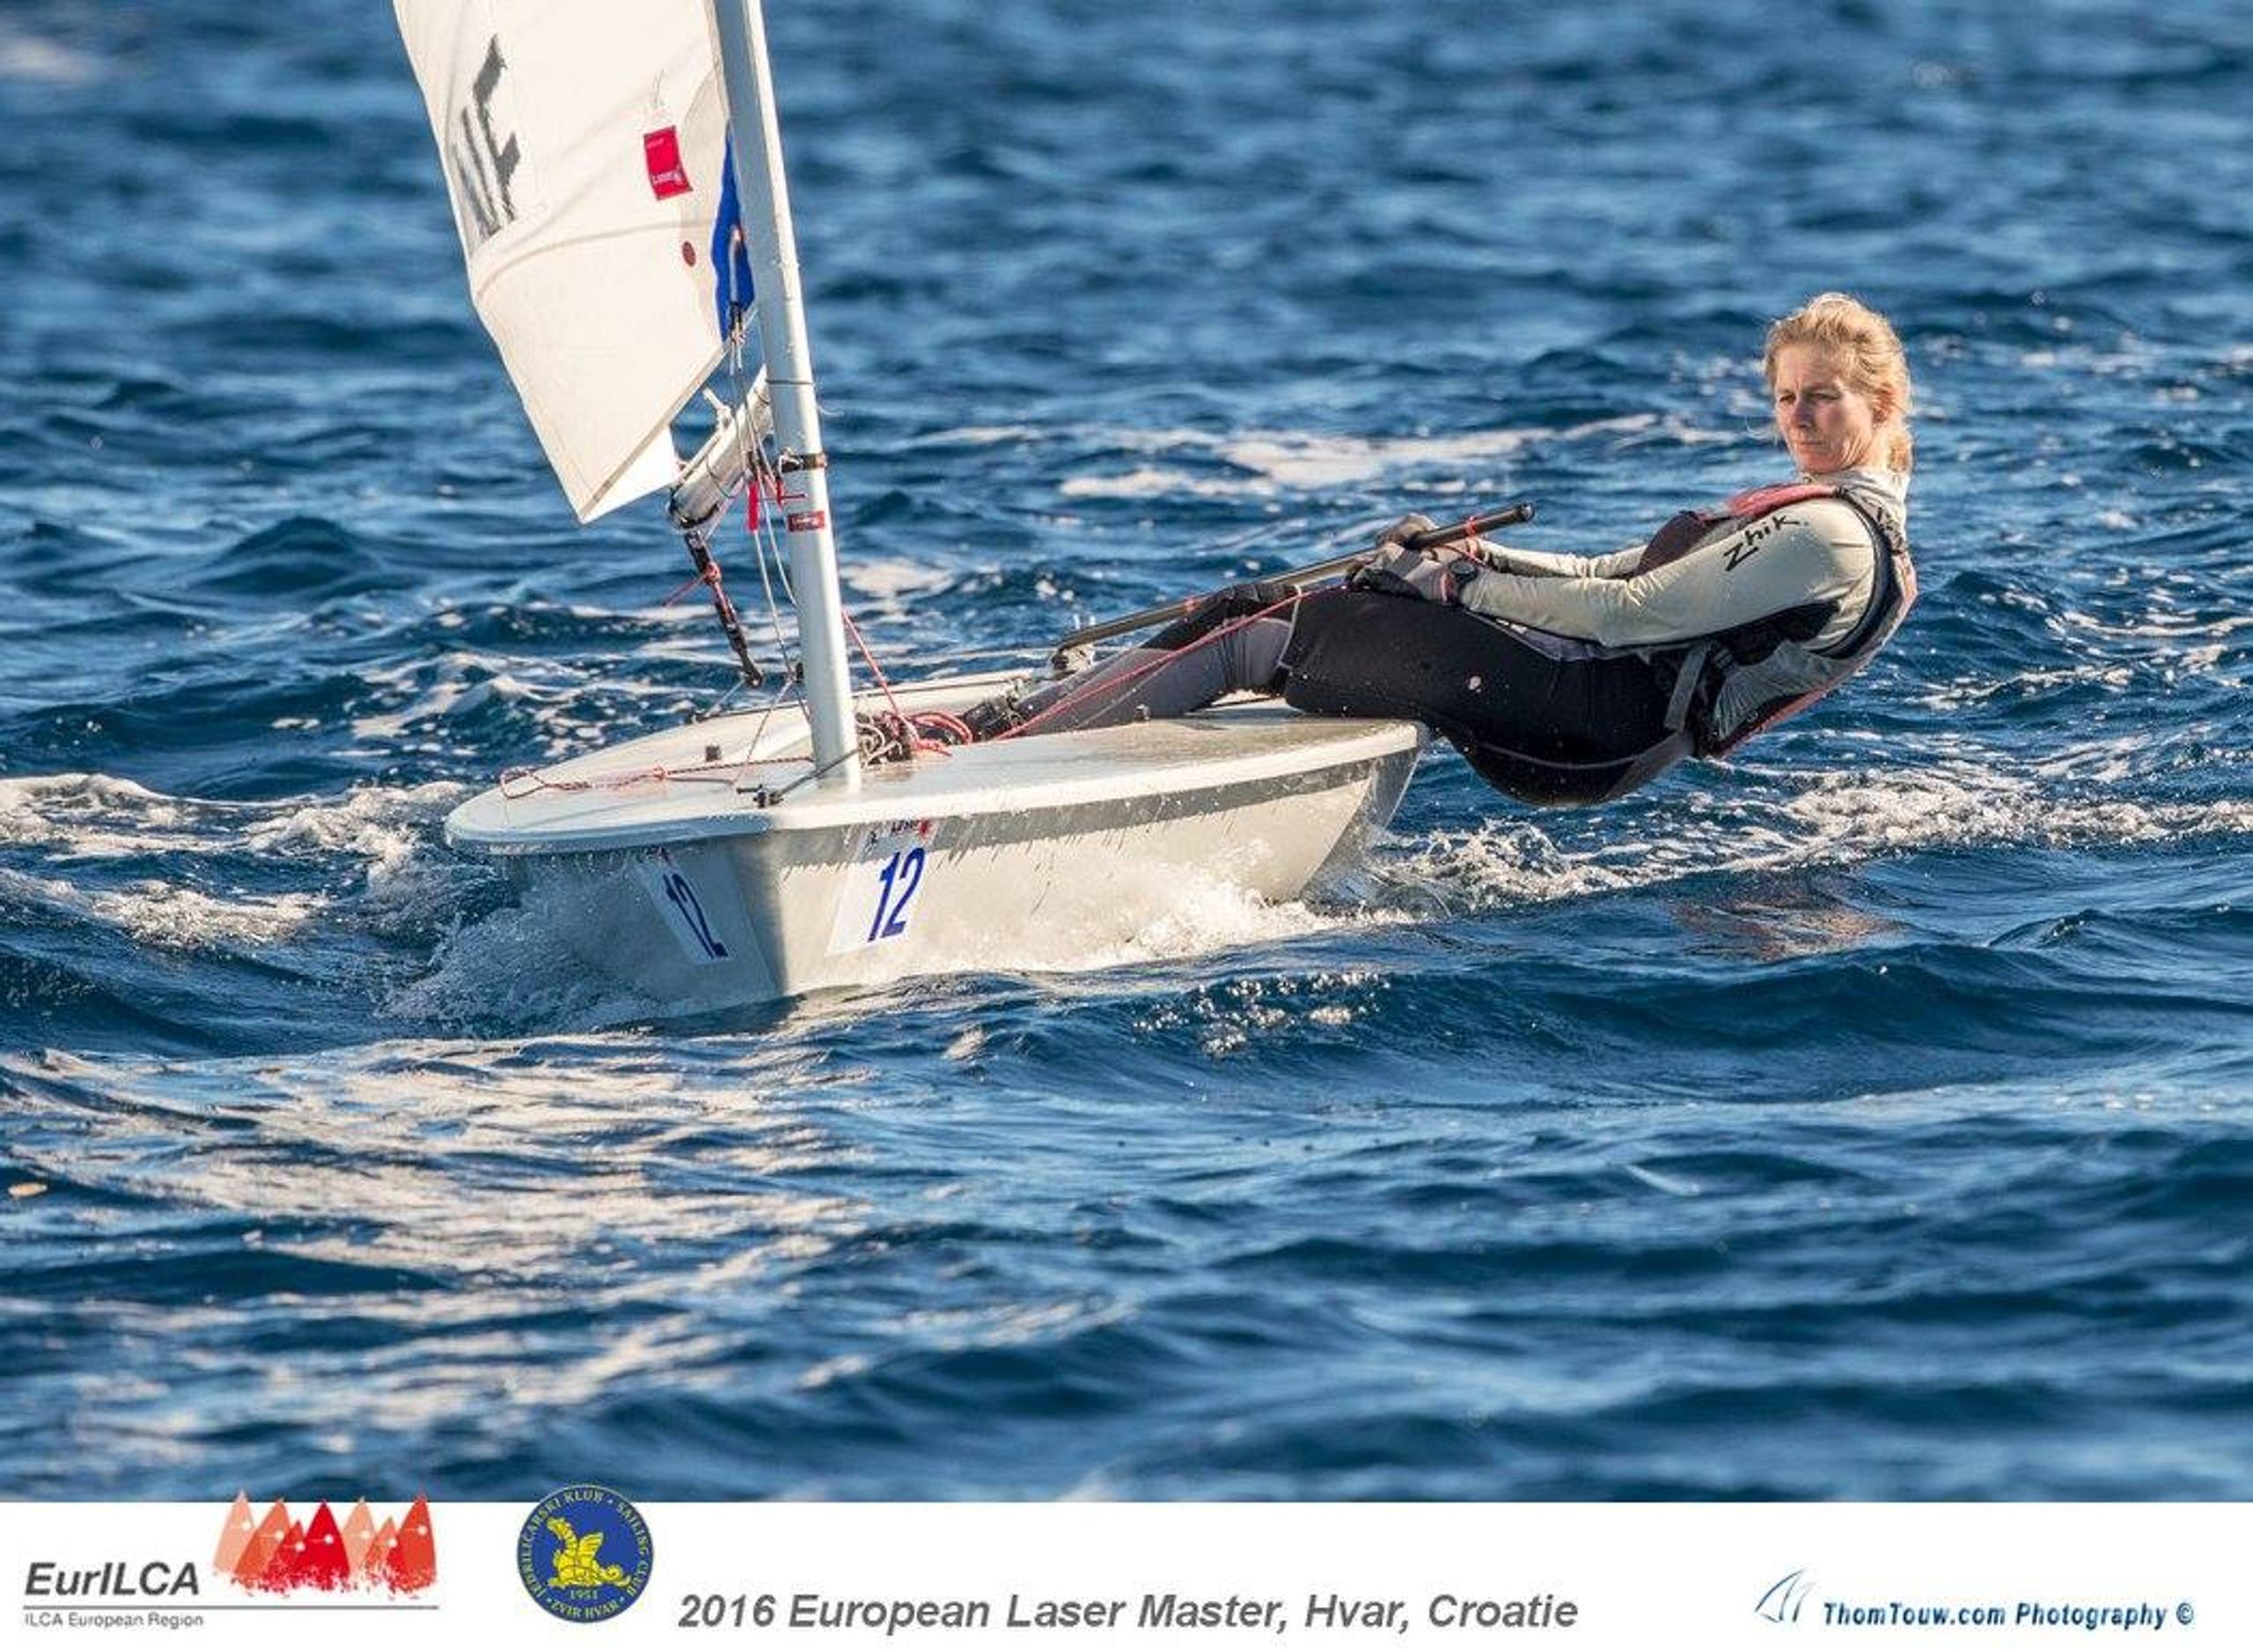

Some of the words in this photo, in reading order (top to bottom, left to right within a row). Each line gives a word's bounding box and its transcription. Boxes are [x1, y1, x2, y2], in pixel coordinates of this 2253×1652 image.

[1722, 515, 1801, 572] Zhik
[662, 872, 729, 959] 12
[867, 847, 927, 943] 12
